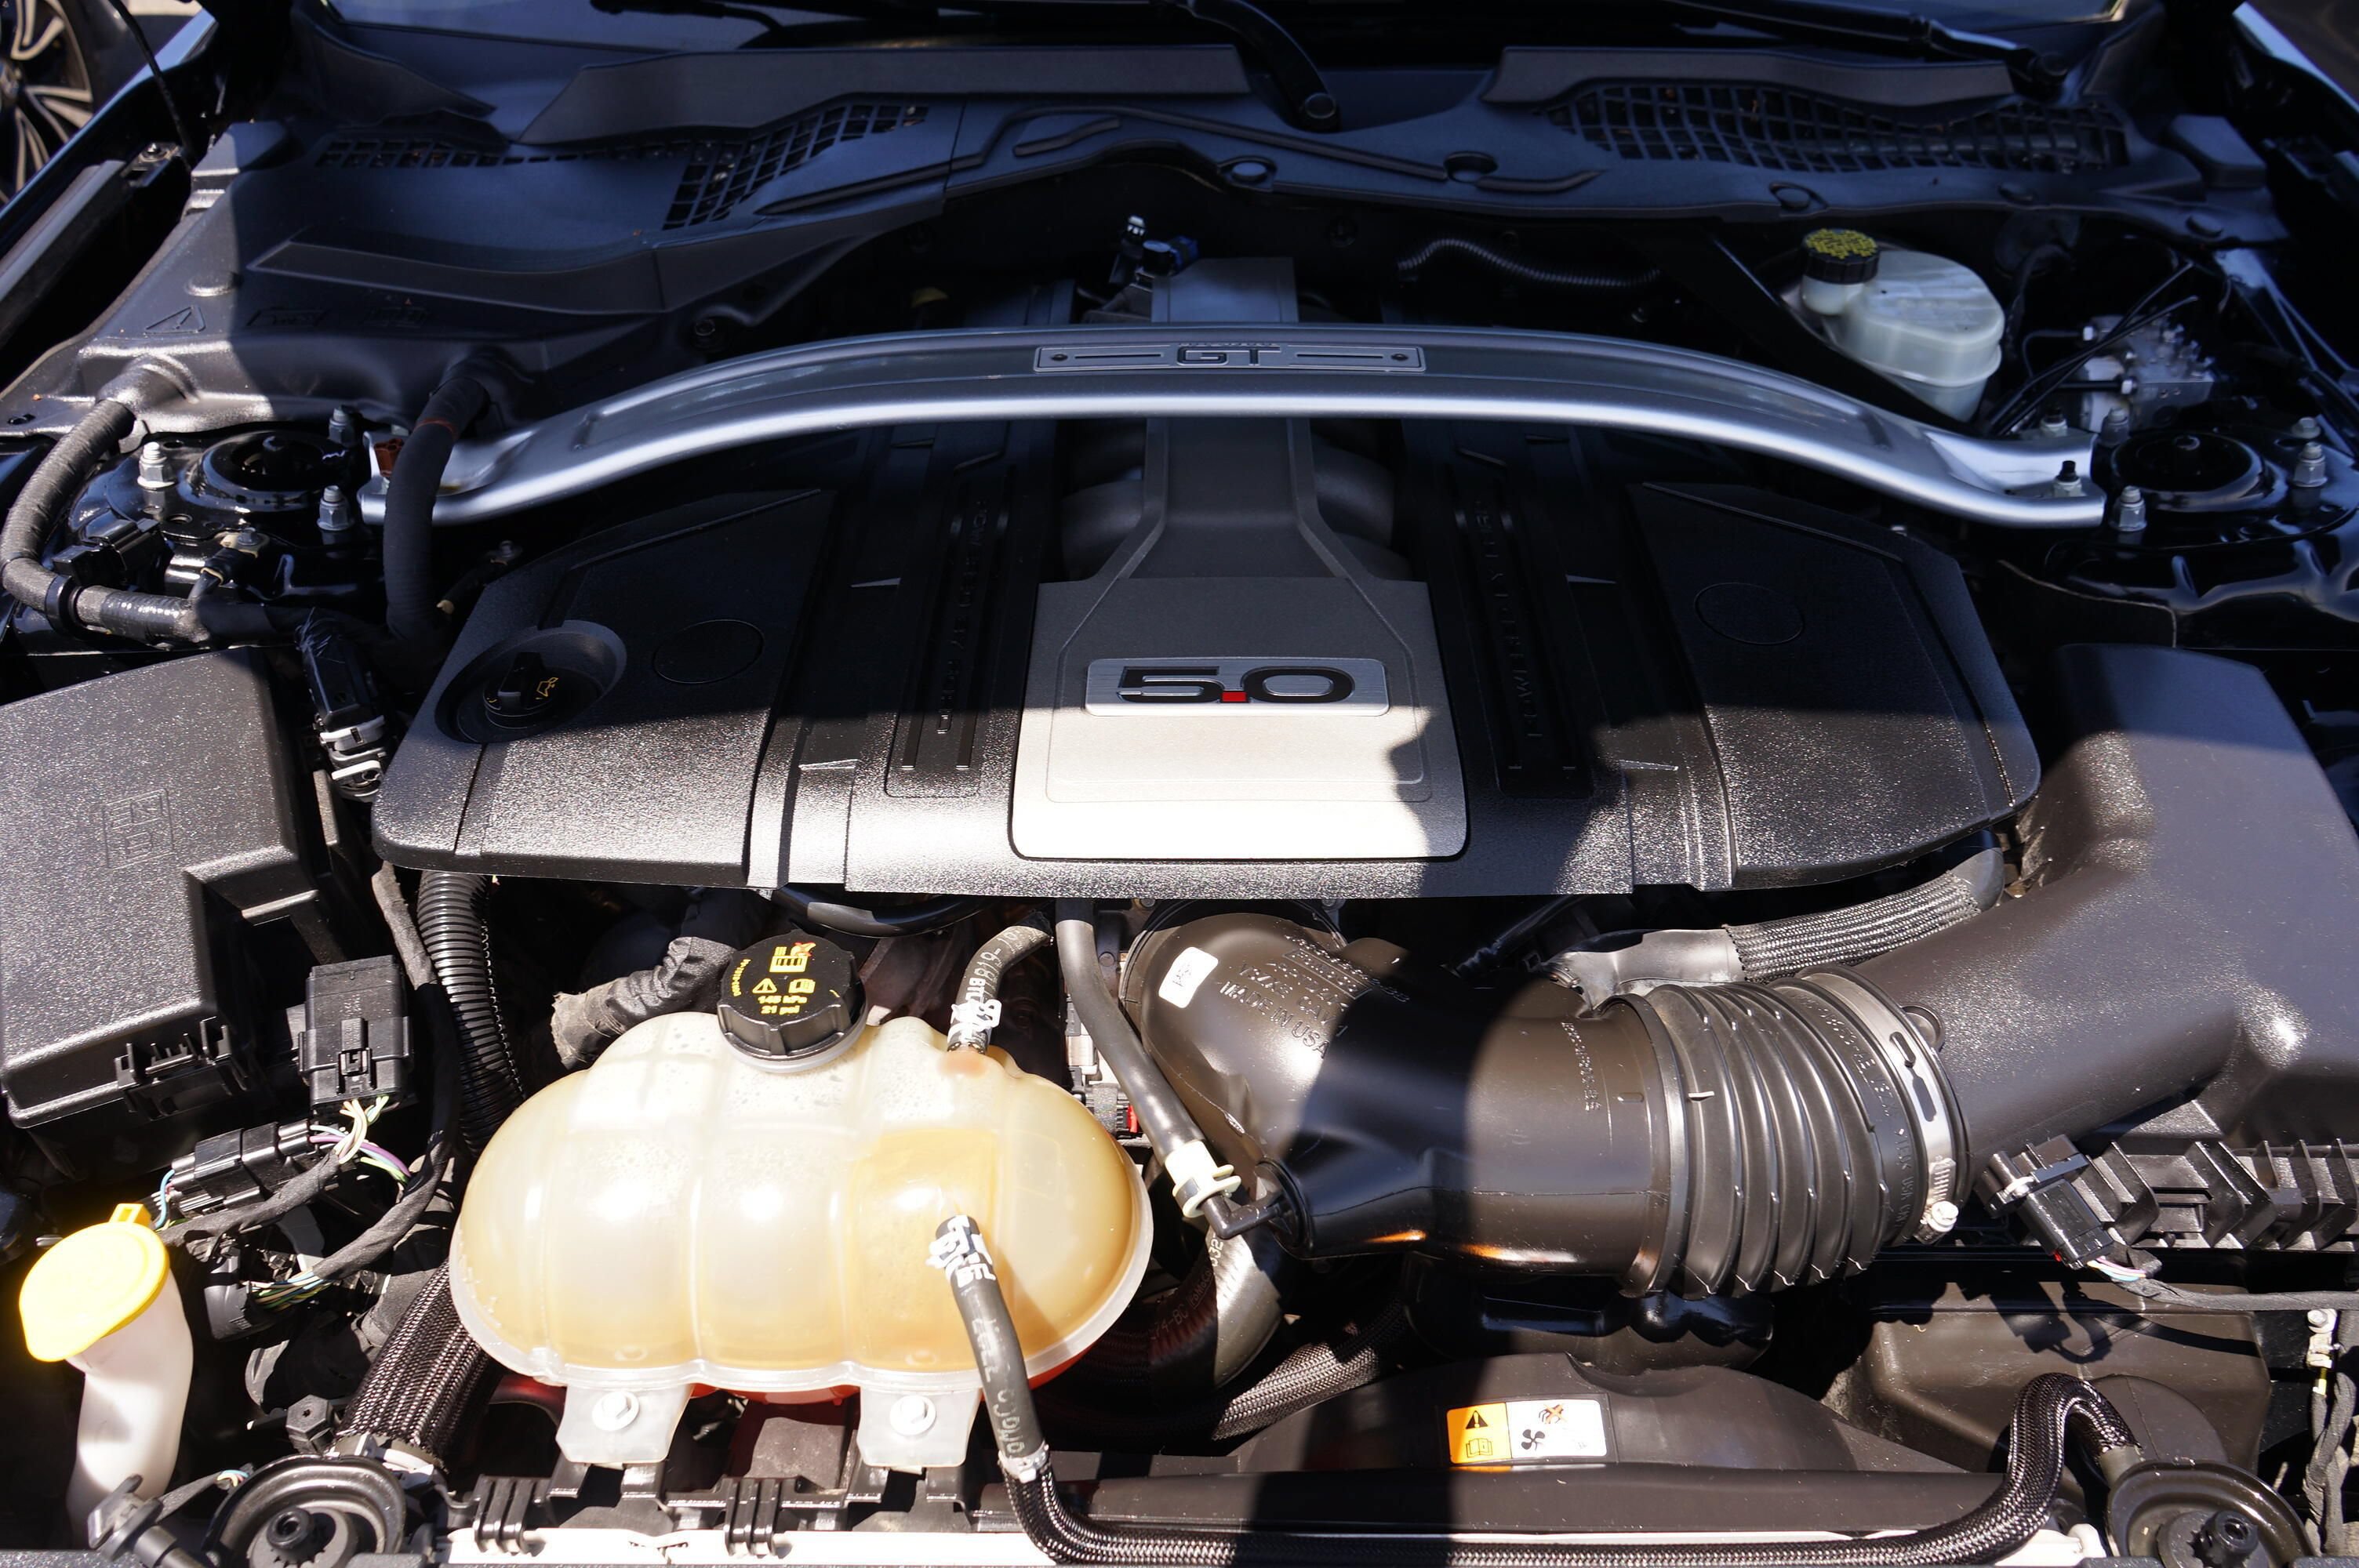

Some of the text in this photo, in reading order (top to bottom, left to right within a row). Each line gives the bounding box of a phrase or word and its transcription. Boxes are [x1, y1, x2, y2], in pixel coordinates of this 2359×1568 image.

[1177, 346, 1280, 365] GT
[1118, 666, 1355, 703] 5.0
[1219, 981, 1330, 1059] MADE IN USA
[956, 1263, 997, 1288] BTL
[993, 1388, 1026, 1458] oMoCo
